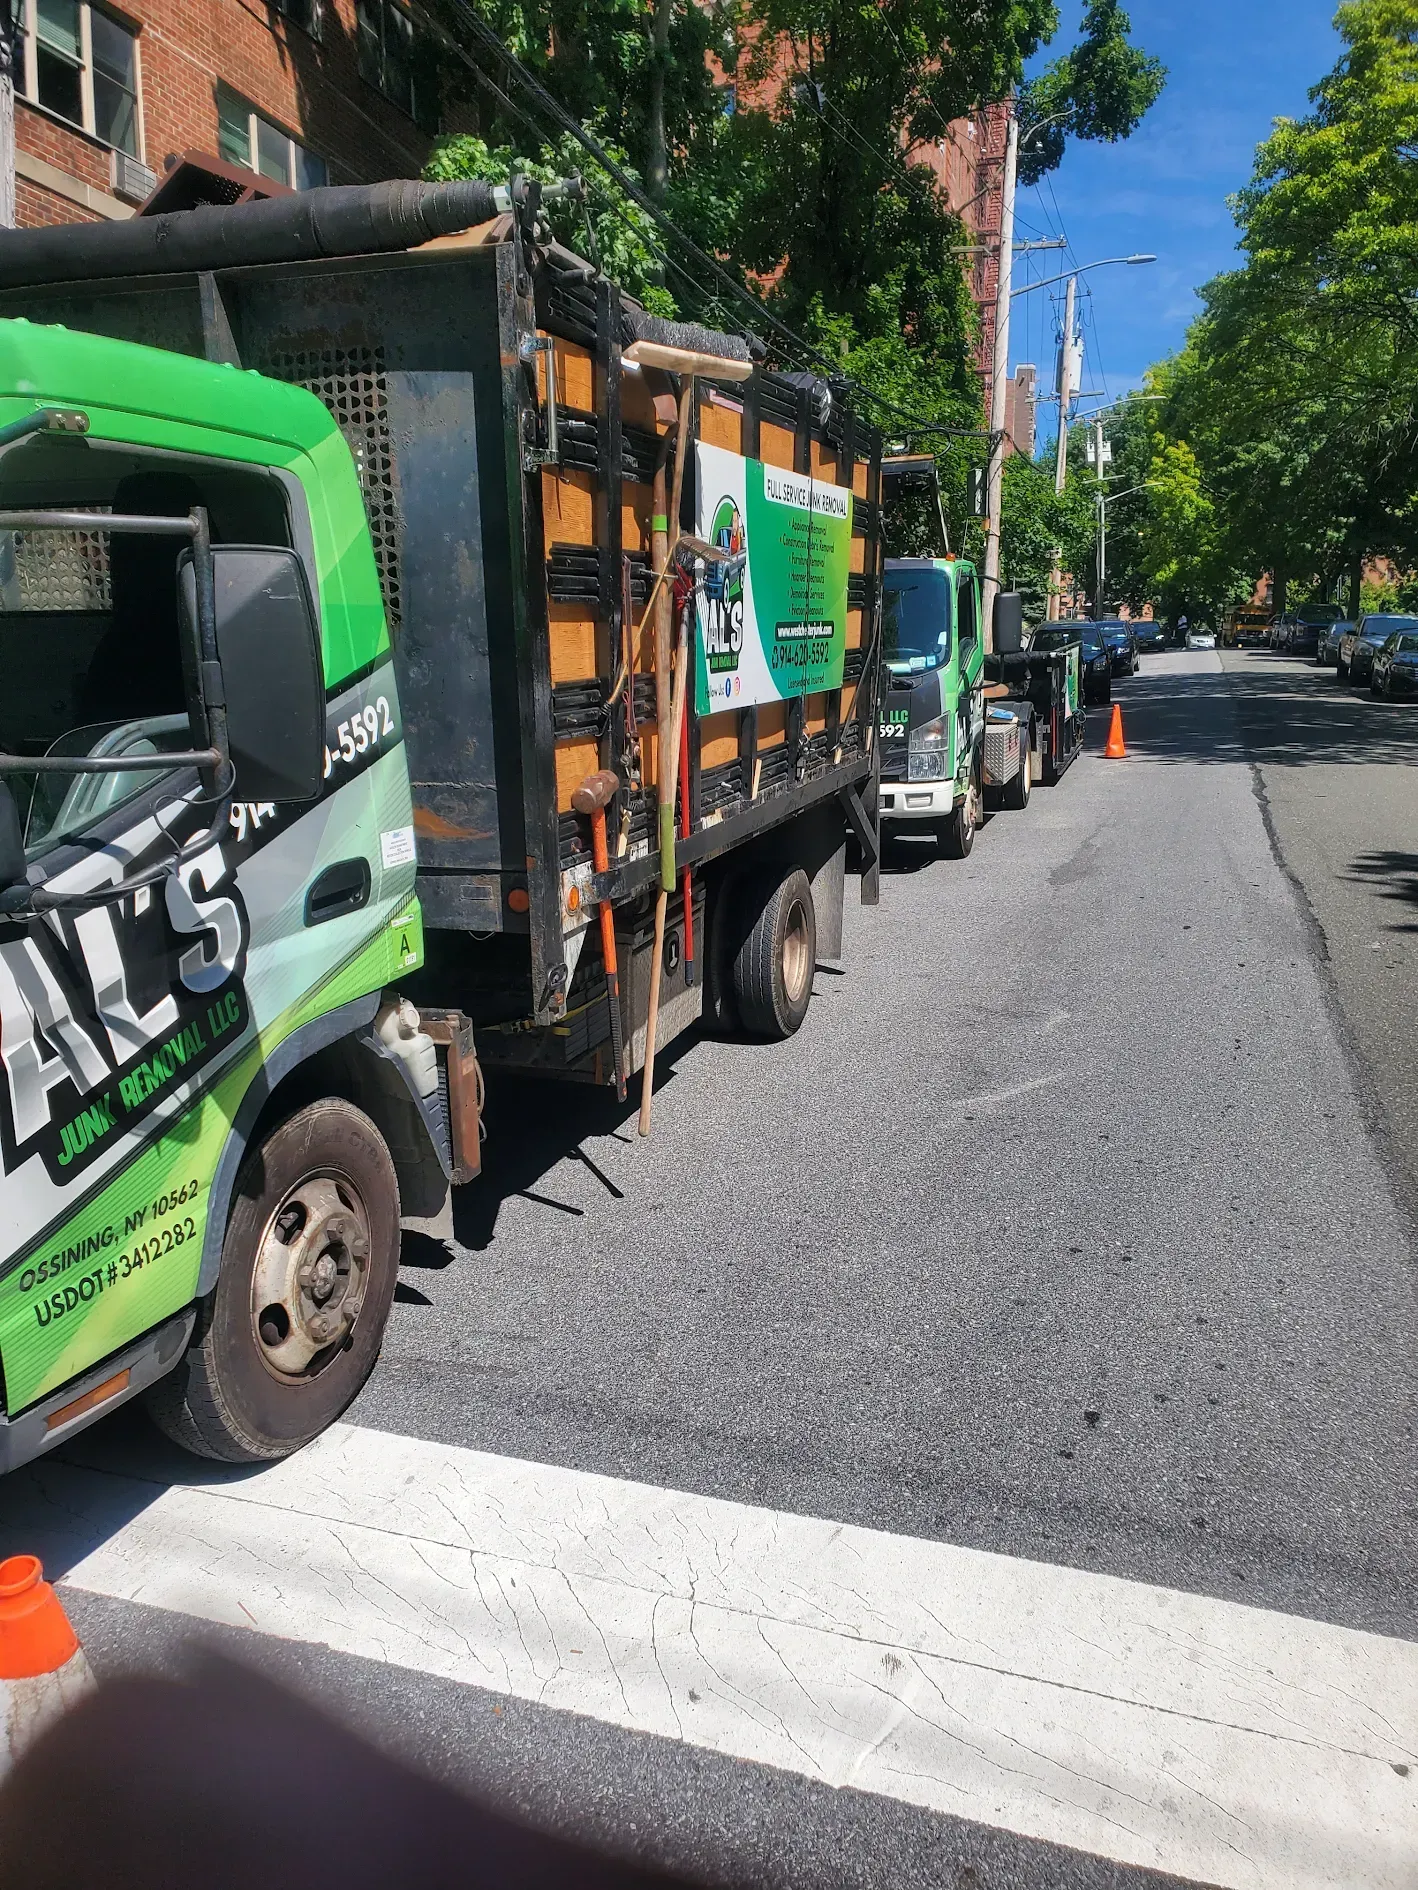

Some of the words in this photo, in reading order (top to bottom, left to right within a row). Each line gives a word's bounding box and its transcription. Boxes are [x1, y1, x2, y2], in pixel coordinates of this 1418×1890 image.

[767, 478, 781, 500] FULL
[783, 483, 806, 506] SERVICE
[822, 494, 846, 516] REMOVAL
[707, 598, 743, 654] AL'S
[777, 621, 832, 640] www.westcheterjunk.com
[780, 642, 829, 668] 914-620-5592
[889, 710, 909, 724] LLC
[57, 1091, 118, 1166] JUNK
[118, 1020, 207, 1114] REMOVAL
[207, 990, 240, 1038] LLC
[19, 1225, 119, 1292] OSSINING,
[123, 1206, 148, 1236] NY
[152, 1178, 199, 1220] 10562
